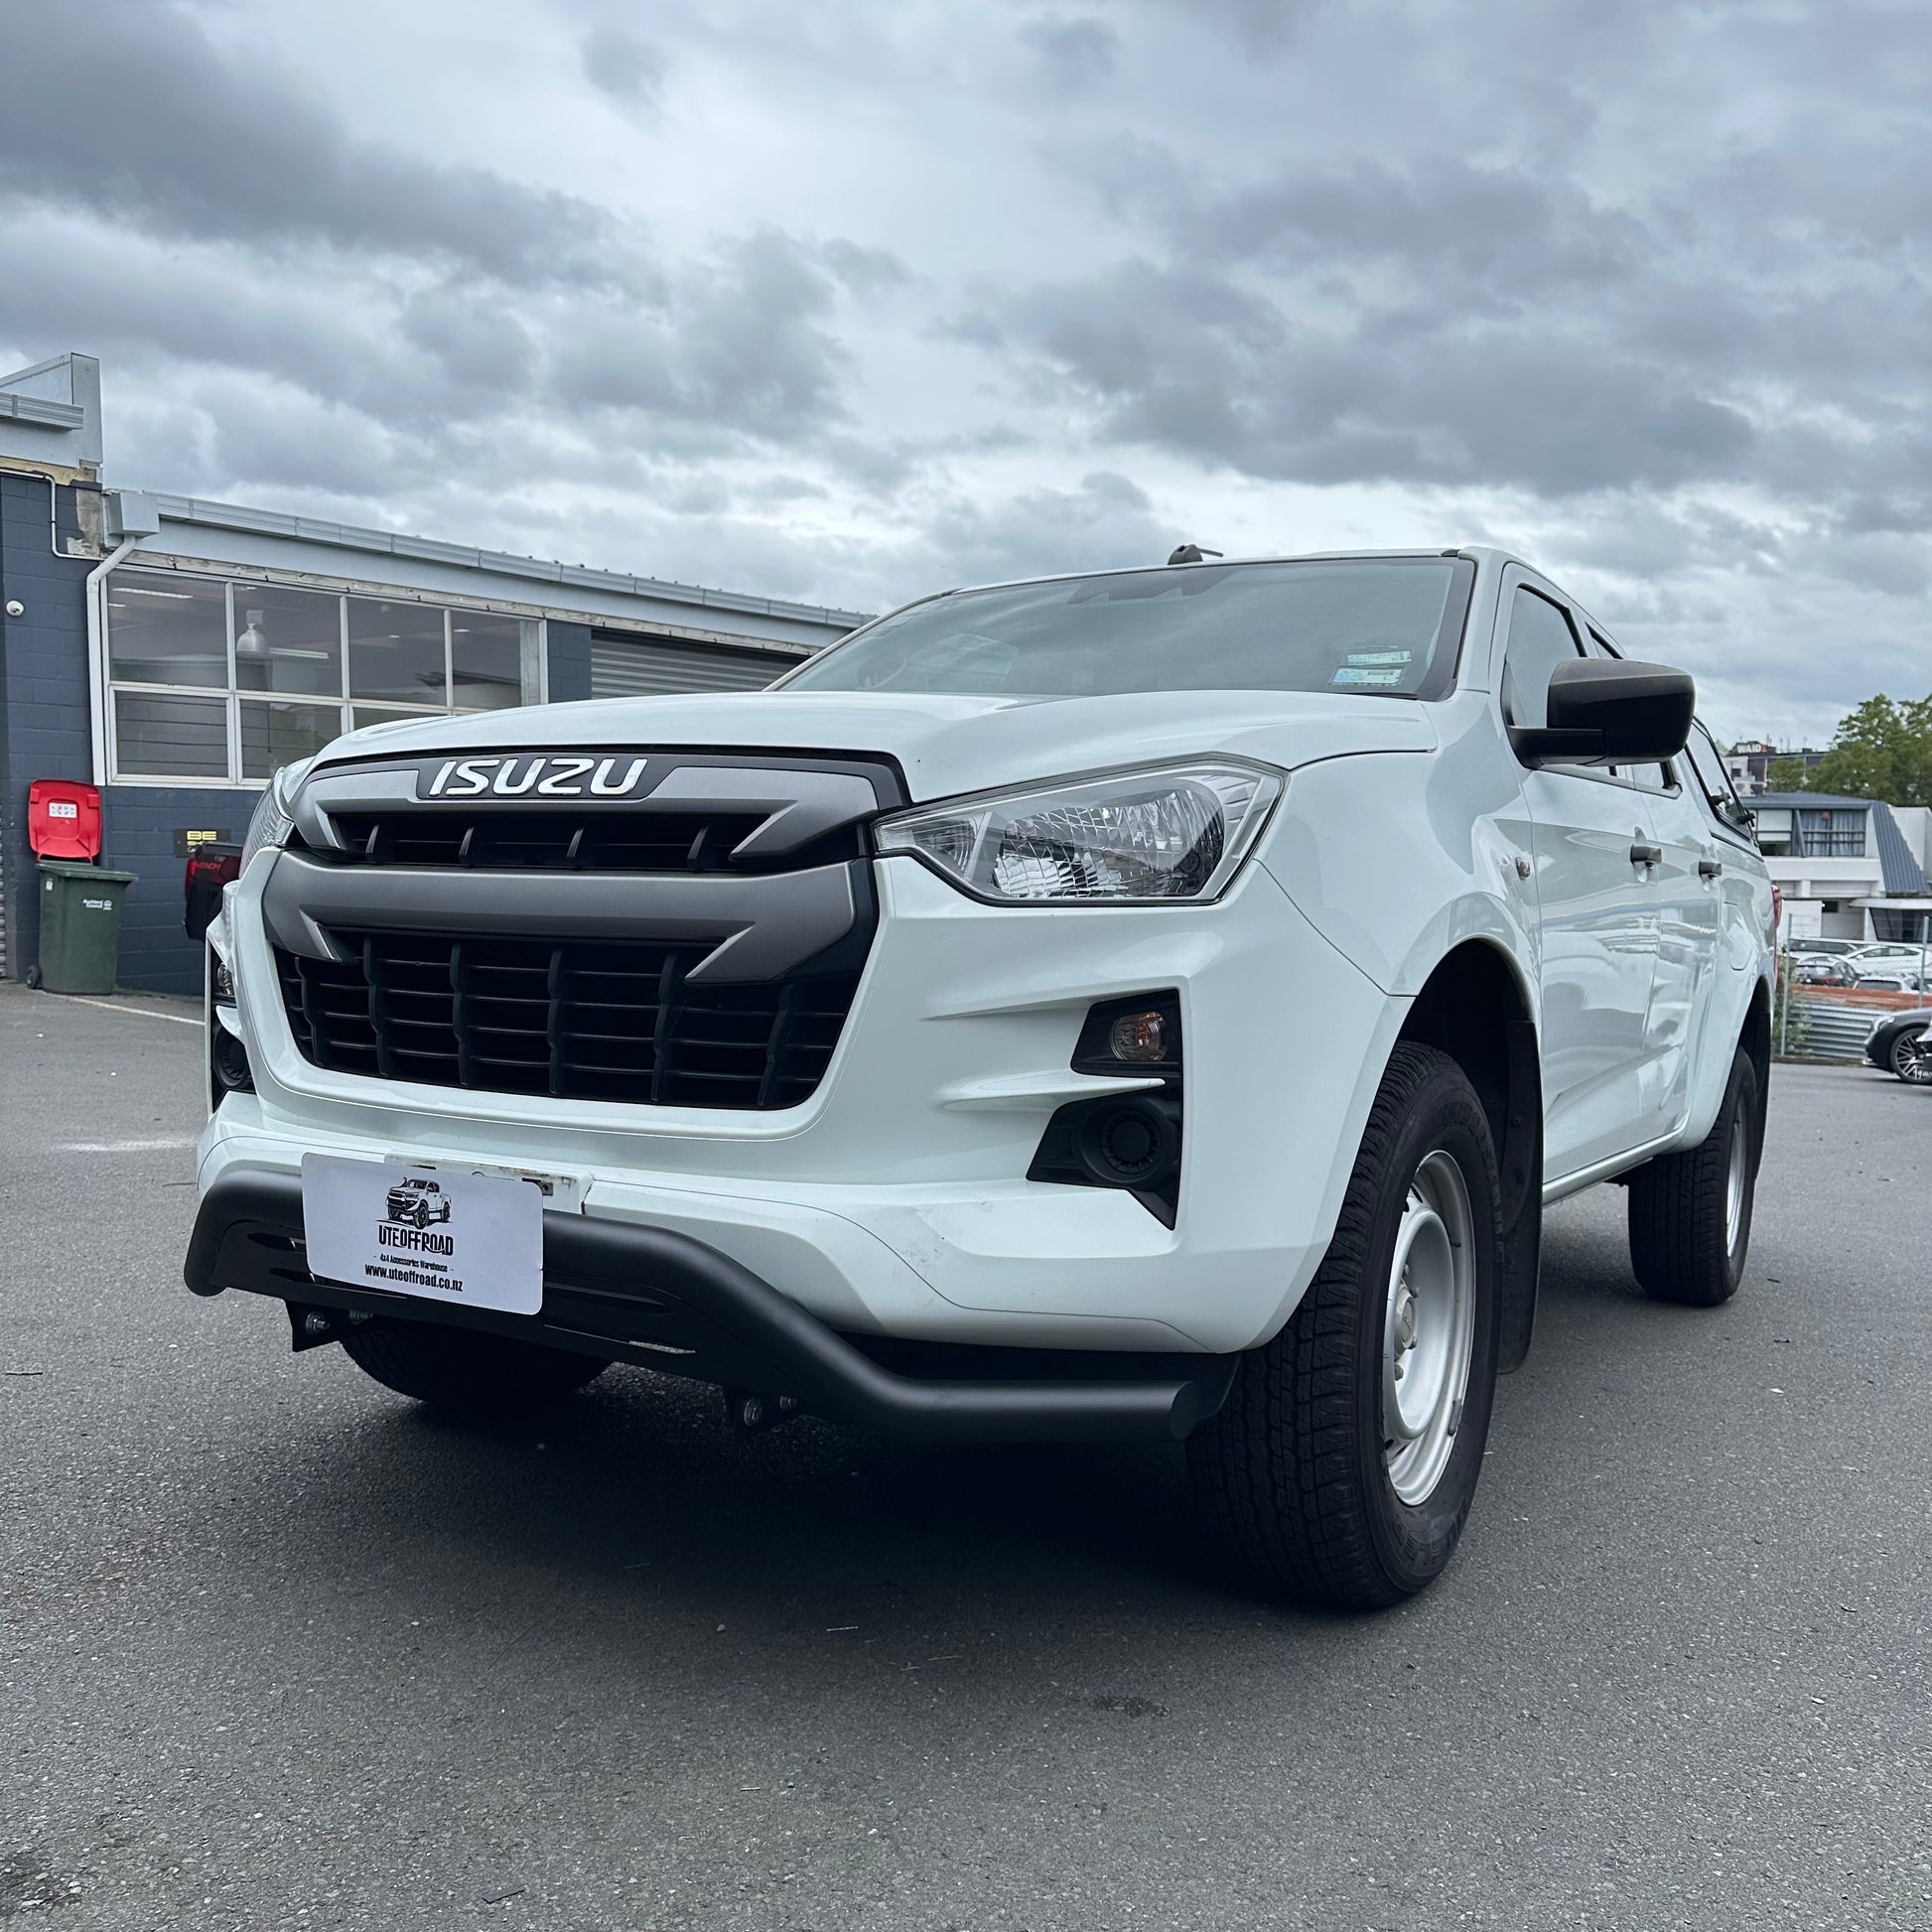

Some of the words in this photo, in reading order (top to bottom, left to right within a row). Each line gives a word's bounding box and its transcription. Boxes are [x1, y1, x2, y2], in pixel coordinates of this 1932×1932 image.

[429, 758, 648, 797] ISUZU
[378, 1224, 454, 1256] UTEOFFROAD
[364, 1264, 464, 1292] www.uteoffroad.co.nz
[380, 1253, 390, 1263] 4x4
[390, 1255, 420, 1269] Accessories
[420, 1259, 448, 1273] Warehouse
